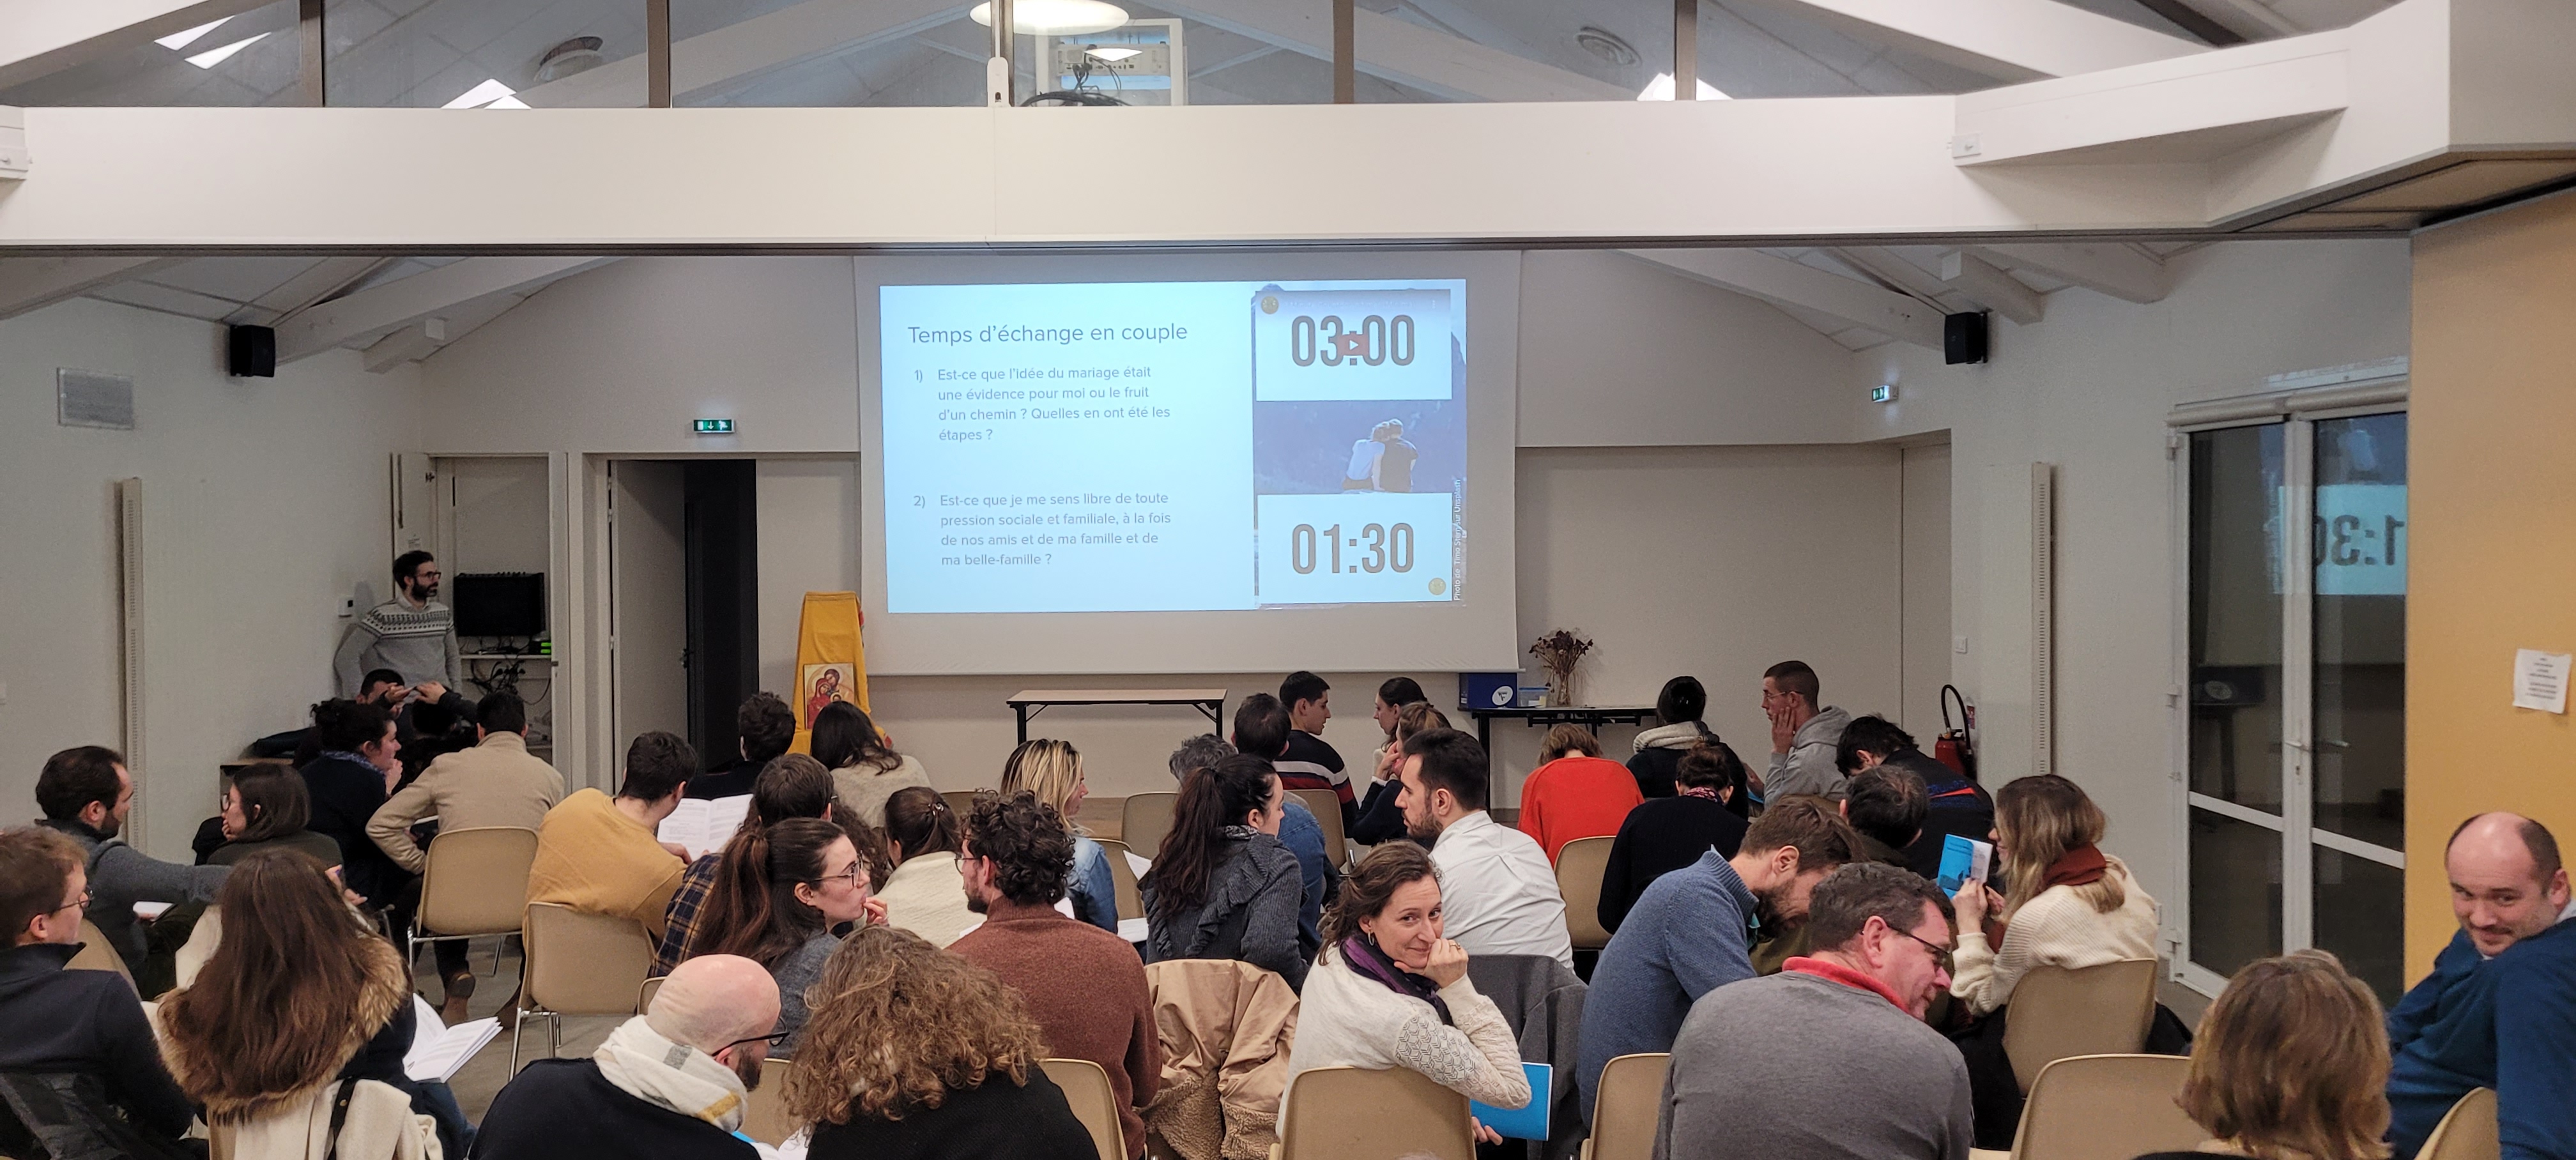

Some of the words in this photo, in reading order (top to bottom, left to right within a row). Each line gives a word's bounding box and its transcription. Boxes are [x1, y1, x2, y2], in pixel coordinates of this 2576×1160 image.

[907, 326, 973, 347] Temps
[1090, 328, 1114, 340] en
[1121, 322, 1188, 344] couple
[914, 369, 923, 383] 1)
[938, 369, 977, 381] Est-ce
[981, 370, 1006, 383] que
[1048, 367, 1064, 379] du
[1068, 367, 1120, 381] mariage
[1123, 366, 1151, 378] était
[938, 392, 962, 401] une
[966, 388, 1025, 401] évidence
[1029, 390, 1059, 402] pour
[1062, 387, 1085, 399] moi
[1089, 389, 1105, 398] ou
[1109, 386, 1121, 398] le
[1124, 386, 1149, 398] fruit
[970, 408, 1016, 420] chemin
[1020, 408, 1027, 420] ?
[1031, 407, 1080, 419] Quelles
[1084, 409, 1100, 418] en
[1103, 407, 1124, 418] ont
[1128, 406, 1149, 418] été
[1152, 406, 1170, 418] les
[939, 429, 983, 443] étapes
[986, 429, 993, 440] ?
[913, 495, 926, 509] 2)
[940, 494, 979, 506] Est-ce
[983, 496, 1008, 508] que
[1009, 494, 1023, 508] je
[1027, 496, 1046, 505] me
[1050, 496, 1080, 505] sens
[1084, 492, 1112, 504] libre
[1115, 492, 1132, 504] de
[1135, 492, 1169, 503] toute
[1453, 479, 1462, 512] Unsplash
[940, 515, 995, 529] pression
[998, 514, 1043, 525] sociale
[1047, 514, 1060, 525] et
[1062, 512, 1119, 526] familiale,
[1123, 512, 1130, 524] à
[1134, 512, 1144, 524] la
[1149, 512, 1171, 524] fois
[940, 534, 957, 546] de
[962, 537, 984, 546] nos
[988, 535, 1017, 546] amis
[1021, 534, 1034, 545] et
[1037, 533, 1054, 545] de
[1058, 535, 1077, 545] ma
[1080, 532, 1123, 544] famille
[1126, 533, 1139, 544] et
[1142, 532, 1158, 544] de
[1292, 523, 1414, 574] 01:30
[942, 556, 960, 565] ma
[965, 553, 1041, 565] belle-famille
[1045, 553, 1052, 565] ?
[1454, 568, 1461, 577] de
